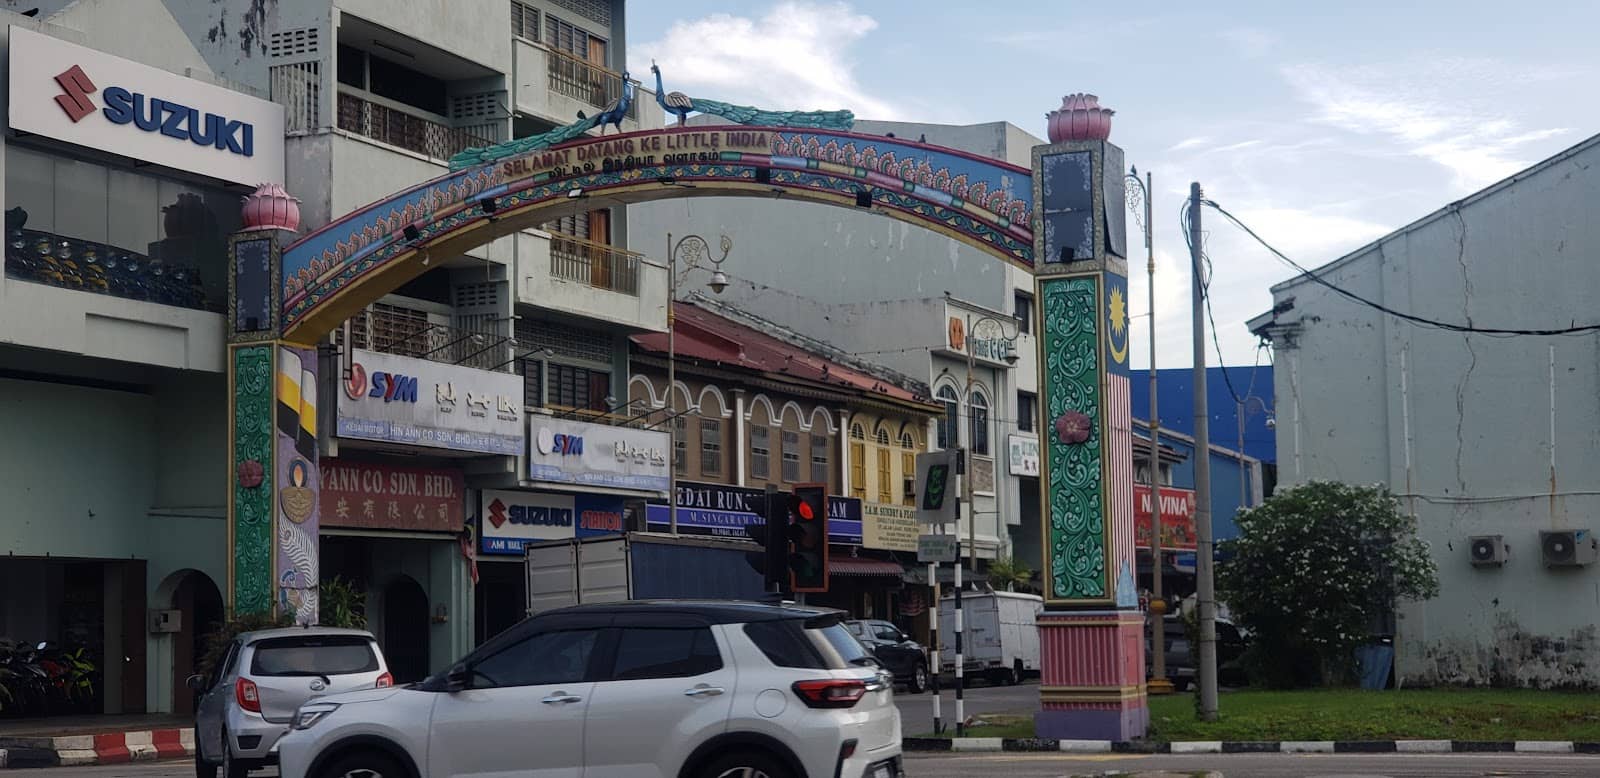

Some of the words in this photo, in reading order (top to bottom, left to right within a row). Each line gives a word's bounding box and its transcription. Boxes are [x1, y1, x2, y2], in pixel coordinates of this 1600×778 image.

[102, 86, 254, 157] SUZUKI
[503, 150, 570, 178] SELAMAT
[577, 139, 633, 160] DATANG
[640, 136, 660, 151] KE
[667, 133, 720, 150] LITTLE
[726, 132, 767, 148] INDIA
[369, 371, 418, 403] SYM
[552, 433, 583, 456] SYM
[363, 469, 387, 494] CO.
[390, 472, 421, 497] SDN.
[424, 474, 457, 498] BHD.
[319, 496, 449, 523] 安有限公司
[667, 487, 711, 510] EDAI
[1142, 494, 1188, 516] NVINA
[509, 504, 573, 527] SUZUKI
